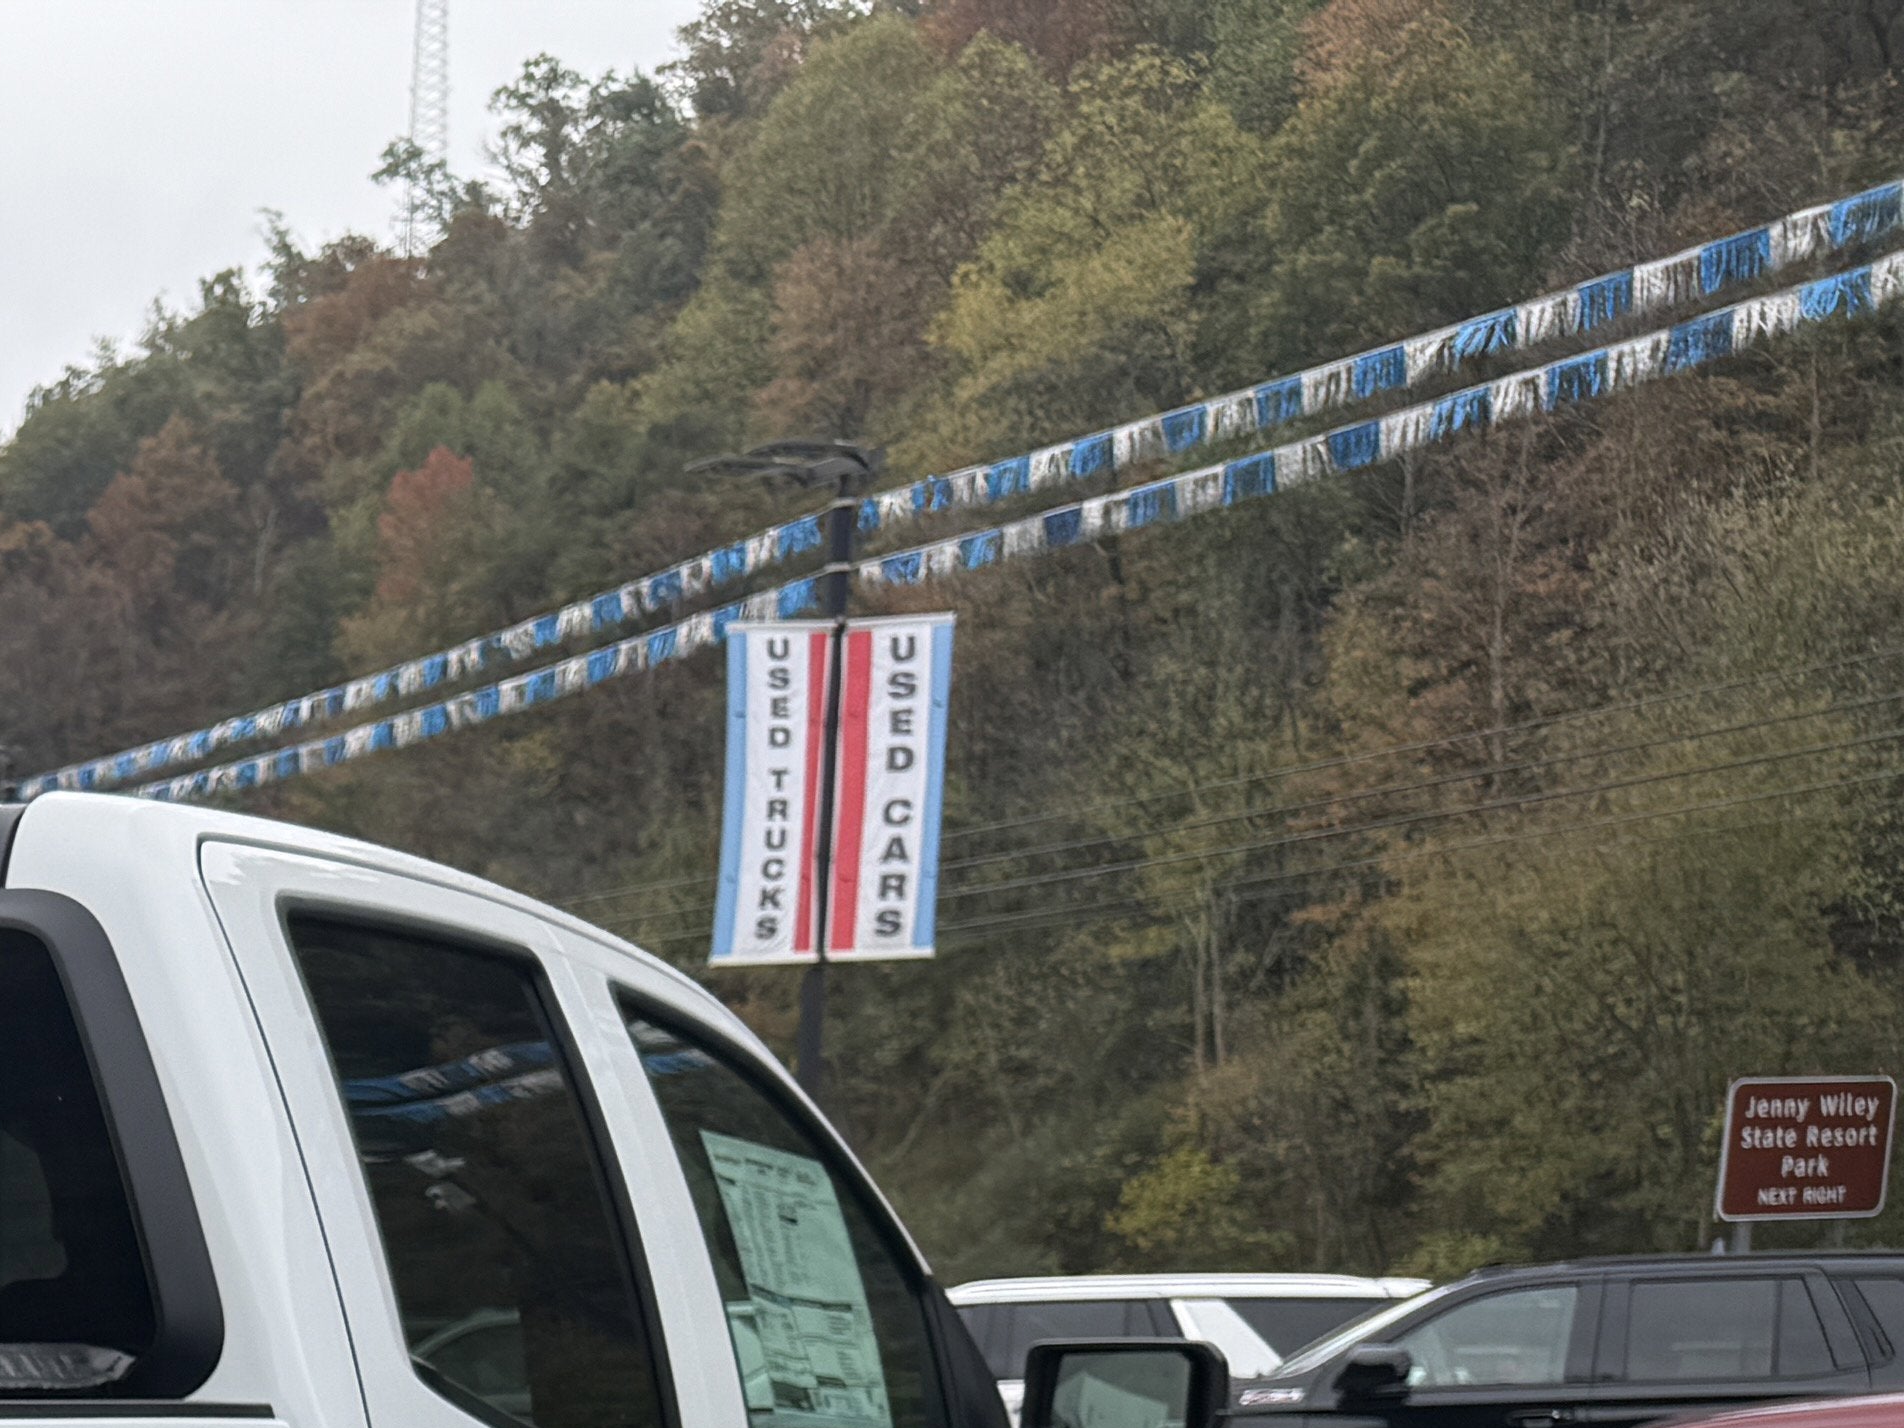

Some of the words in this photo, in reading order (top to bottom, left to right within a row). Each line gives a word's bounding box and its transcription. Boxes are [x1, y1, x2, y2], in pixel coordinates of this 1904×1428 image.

[766, 637, 792, 749] USED
[885, 635, 917, 772] USED
[754, 768, 792, 942] TRUCKS
[873, 799, 915, 937] CARS
[1740, 1125, 1798, 1149] State
[1806, 1123, 1878, 1148] Resort
[1744, 1095, 1811, 1123] Jenny
[1820, 1091, 1880, 1121] Wiley
[1756, 1186, 1798, 1206] NEXT
[1802, 1184, 1847, 1205] RIGHT
[1780, 1153, 1830, 1179] Park
